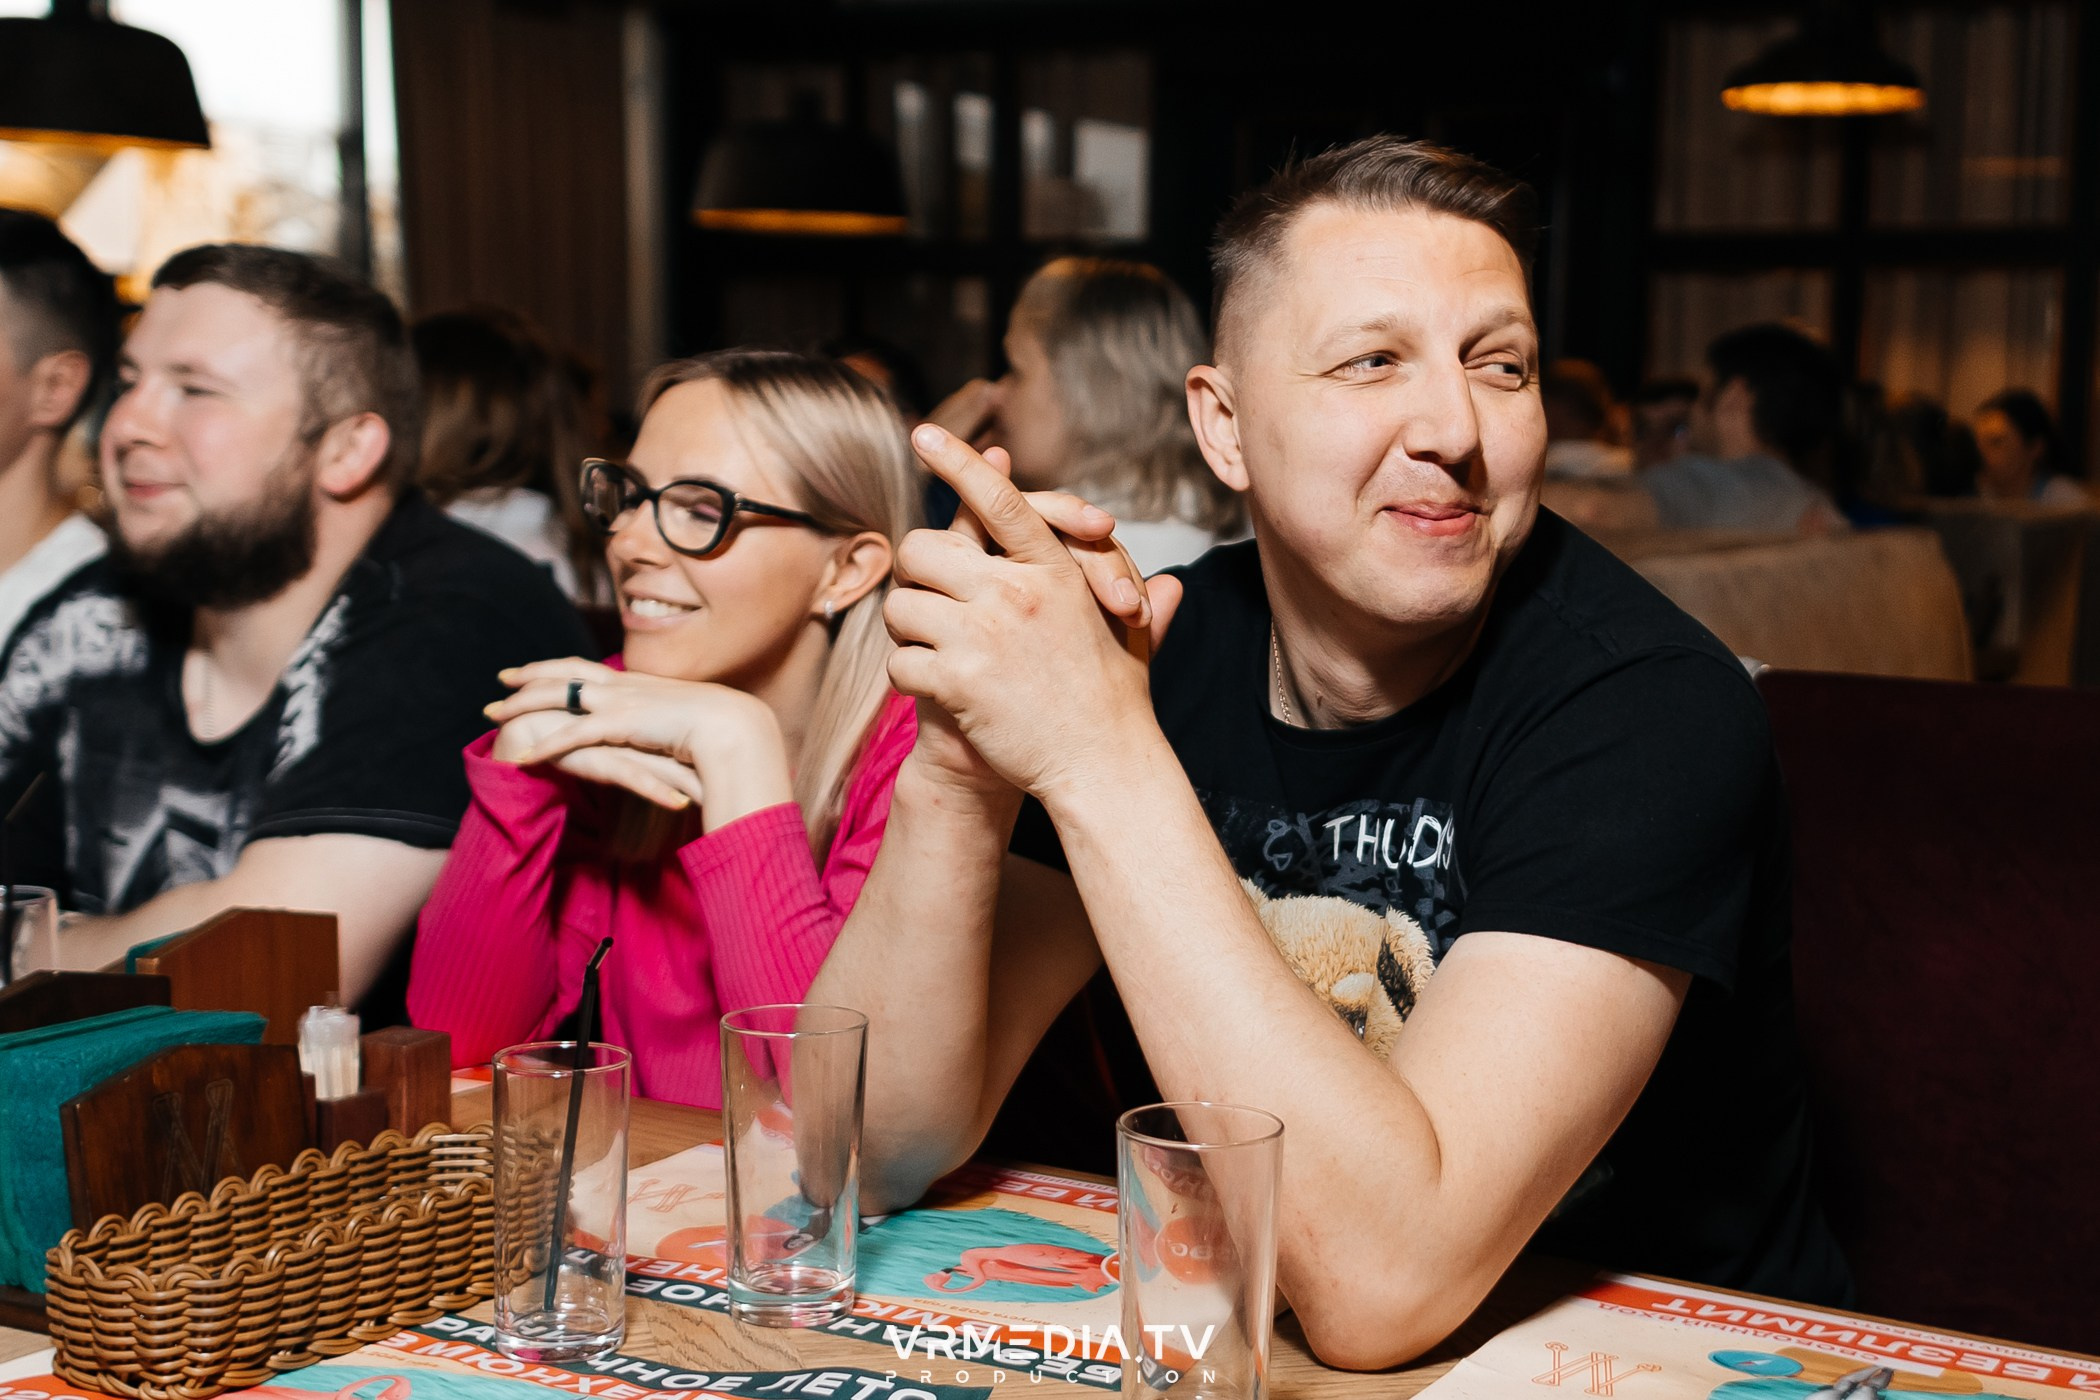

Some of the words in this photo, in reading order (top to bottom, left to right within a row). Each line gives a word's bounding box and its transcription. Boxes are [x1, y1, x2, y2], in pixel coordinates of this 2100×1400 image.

[1598, 1302, 1675, 1322] ВХОД
[1652, 1298, 2052, 1380] БЕЗЛИМИТ
[1681, 1317, 1880, 1361] СВОБОДНЫЙ
